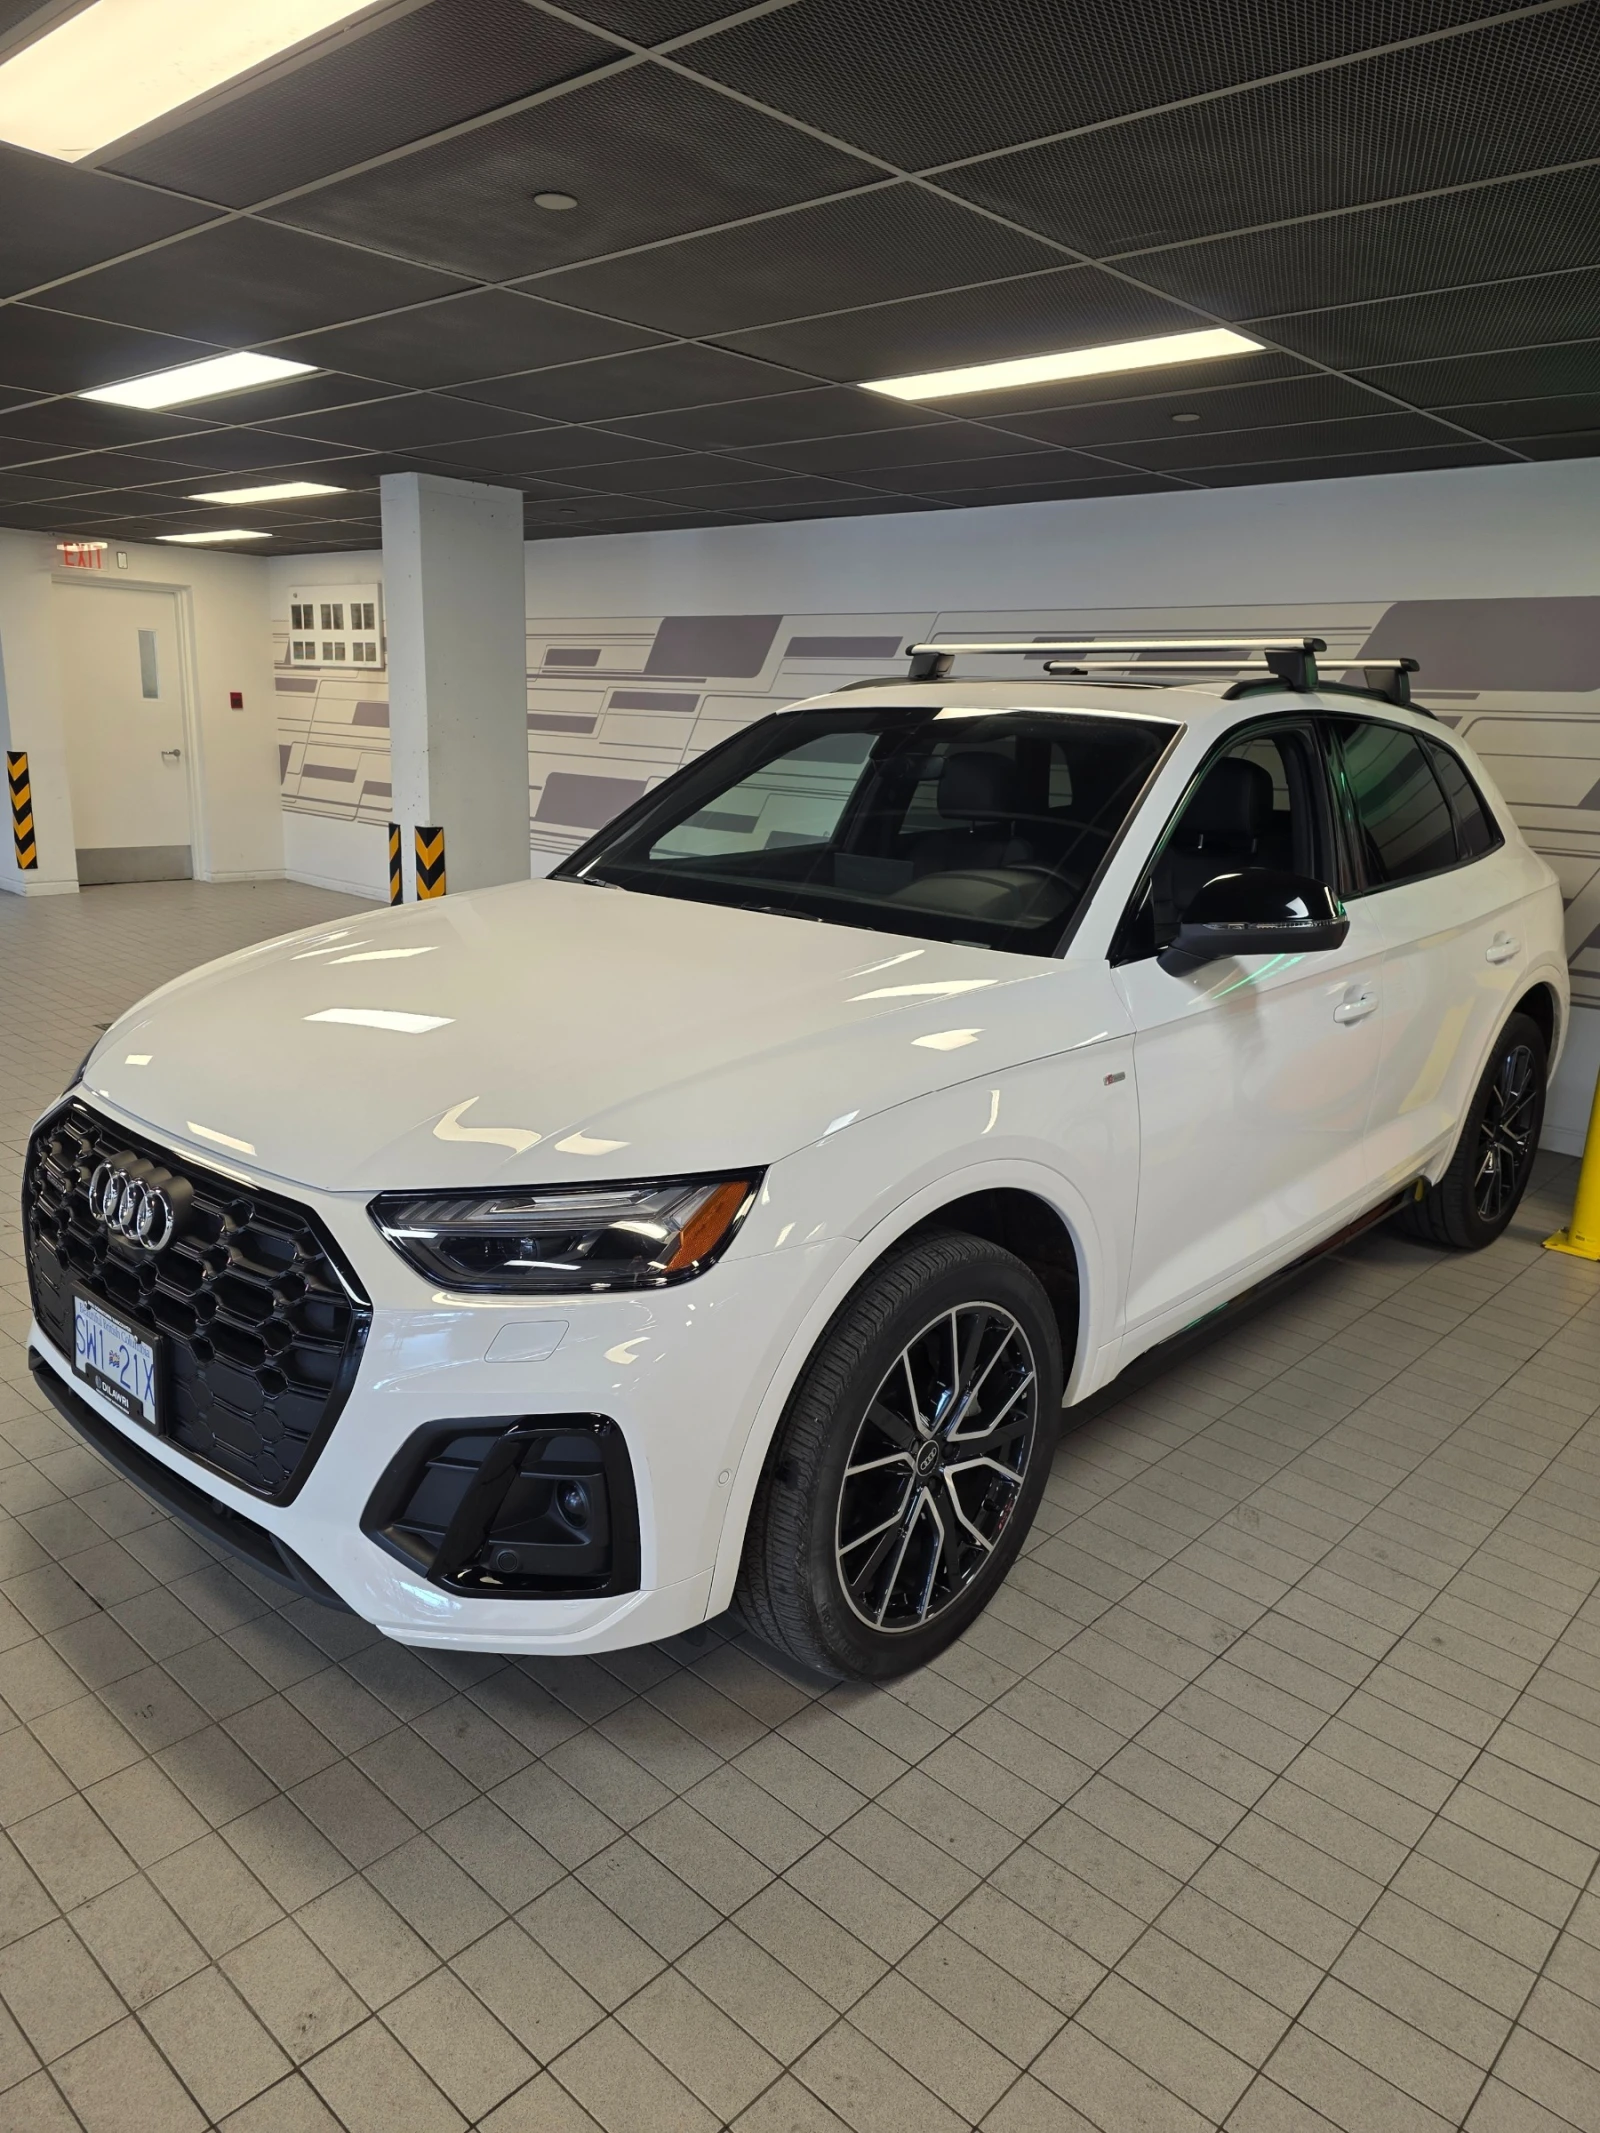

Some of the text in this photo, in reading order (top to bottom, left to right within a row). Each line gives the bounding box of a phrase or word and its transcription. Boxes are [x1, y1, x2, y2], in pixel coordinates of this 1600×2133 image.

[62, 541, 103, 569] EXIT
[102, 1318, 121, 1340] British
[121, 1331, 150, 1358] Columbia
[119, 1344, 155, 1406] 21X
[101, 1381, 129, 1408] DILAWRI
